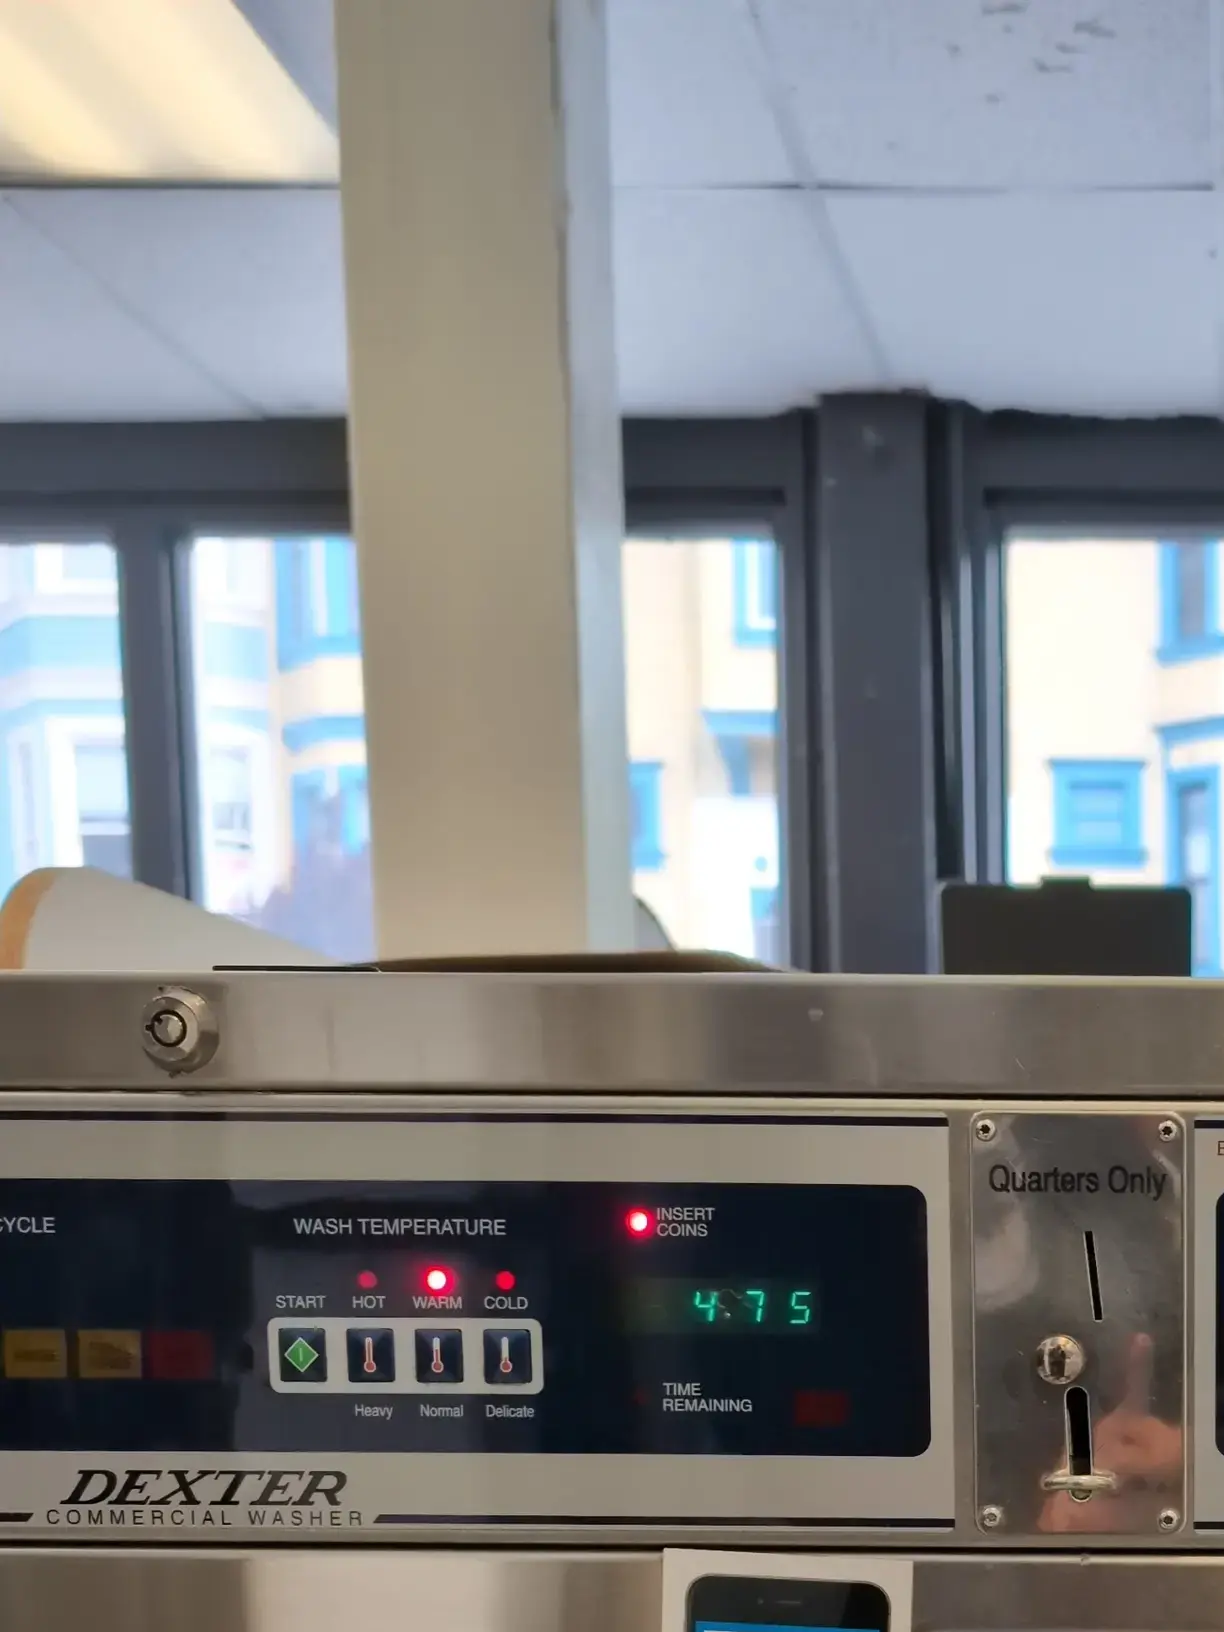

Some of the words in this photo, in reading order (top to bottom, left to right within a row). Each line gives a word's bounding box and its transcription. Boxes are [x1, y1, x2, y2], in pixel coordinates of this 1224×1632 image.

[988, 1164, 1100, 1195] Quarters
[1108, 1166, 1168, 1201] Only
[656, 1207, 715, 1221] INSERT
[293, 1218, 352, 1235] WASH
[357, 1218, 507, 1235] TEMPERATURE
[656, 1223, 708, 1237] COINS
[275, 1296, 326, 1309] START
[352, 1296, 386, 1309] HOT
[412, 1296, 463, 1310] WARM
[484, 1296, 528, 1310] COLD
[663, 1383, 701, 1396] TIME
[355, 1404, 393, 1419] Heavy
[420, 1404, 463, 1417] Normal
[486, 1405, 535, 1418] Delicate
[662, 1398, 753, 1412] REMAINING
[60, 1468, 348, 1506] DEXTER
[46, 1509, 231, 1526] COMMERCIAL
[249, 1510, 363, 1526] WASHER
